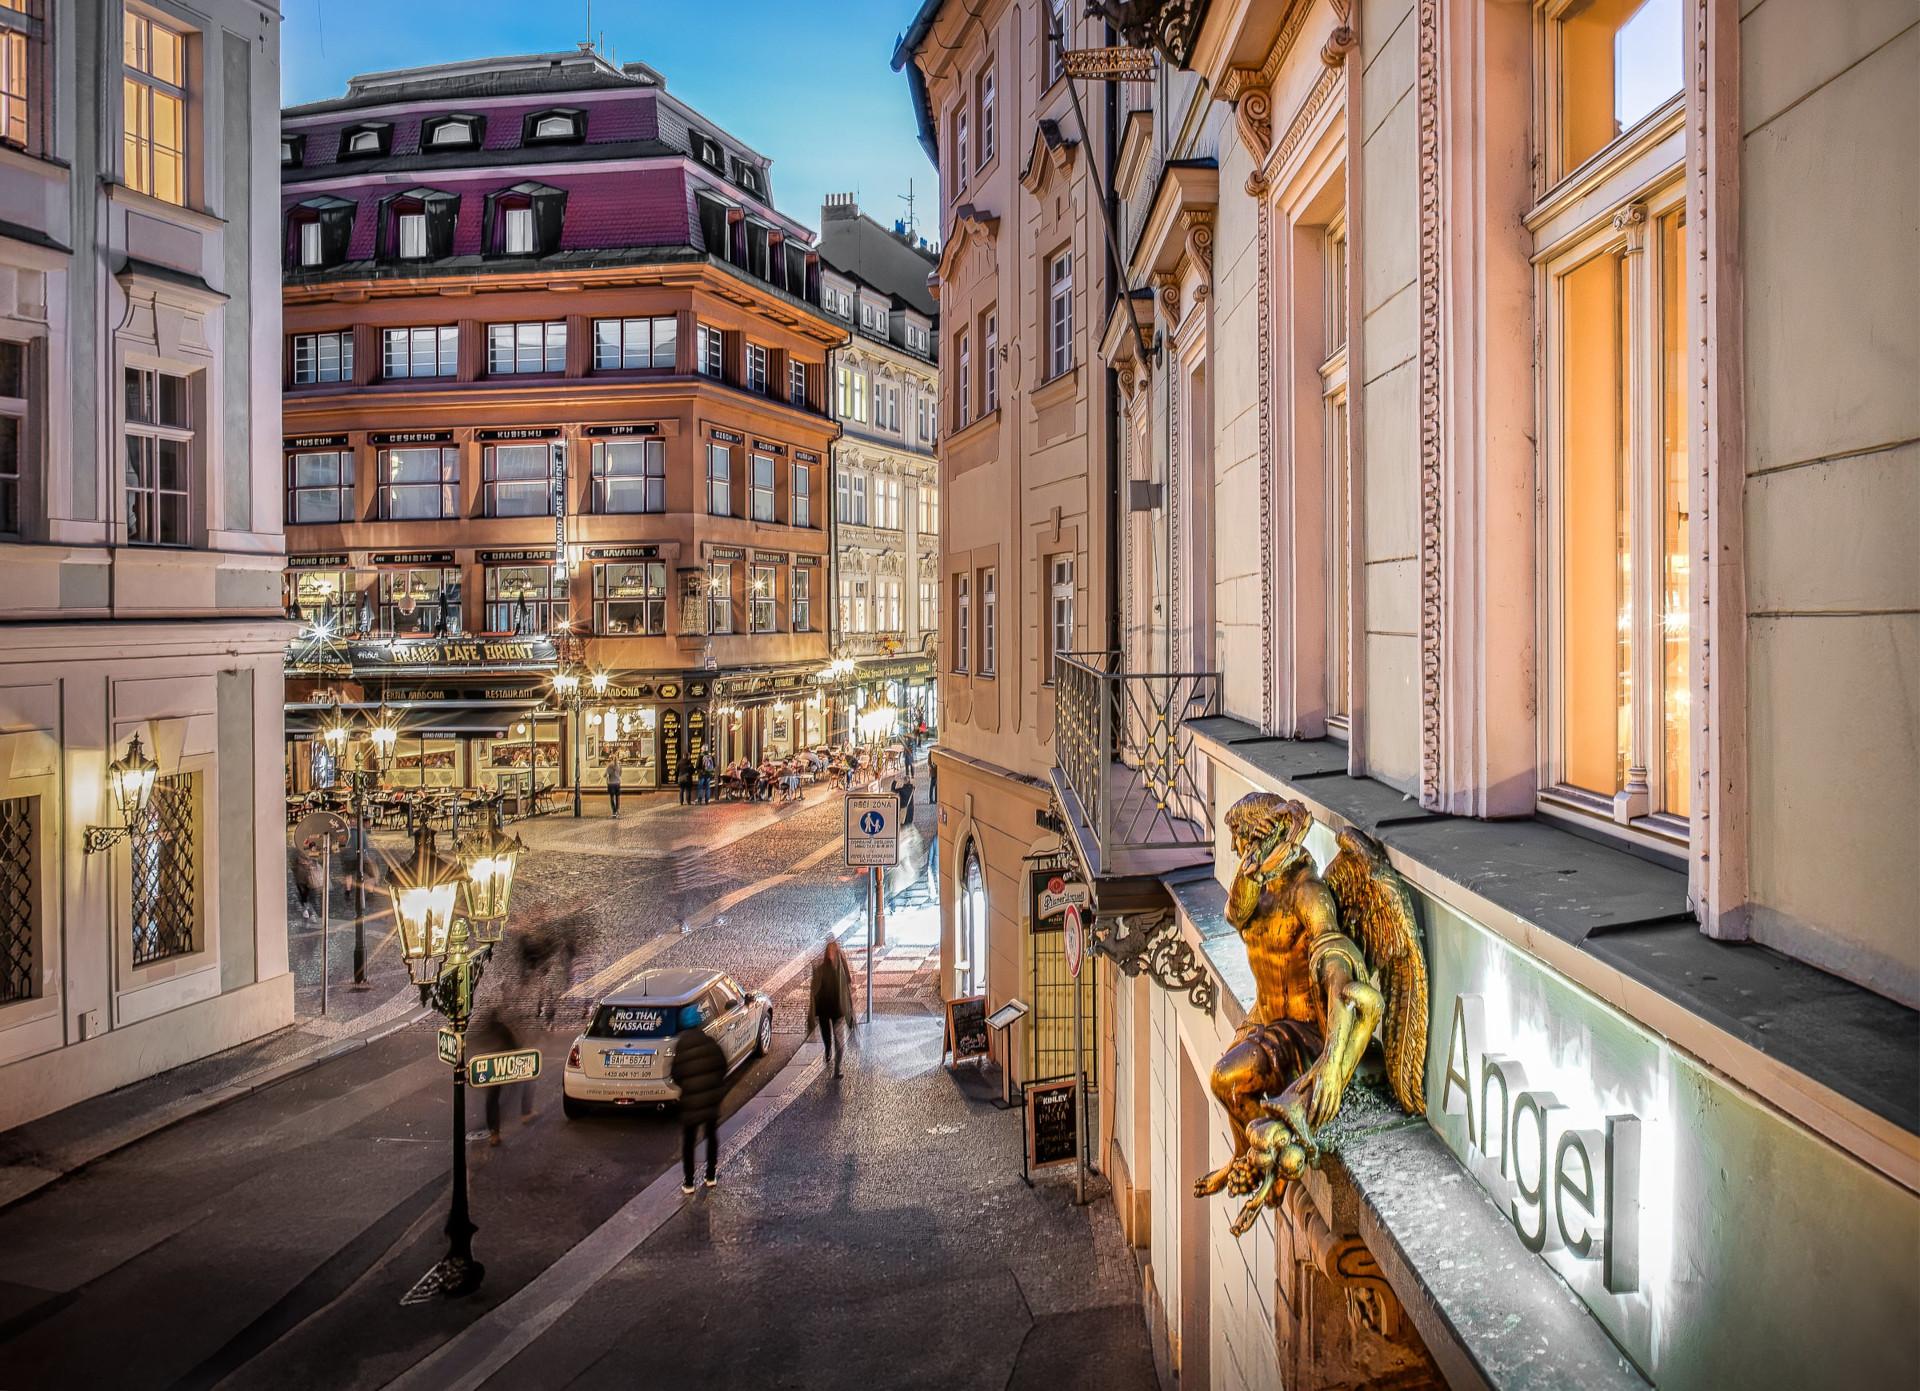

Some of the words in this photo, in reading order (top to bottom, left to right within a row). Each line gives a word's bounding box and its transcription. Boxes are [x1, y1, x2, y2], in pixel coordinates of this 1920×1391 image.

[391, 645, 439, 663] GRAND
[483, 642, 534, 660] ORIENT
[485, 689, 533, 699] RESTAURANT
[872, 799, 892, 809] ZÓNA
[615, 1011, 633, 1020] PRO
[635, 1011, 657, 1020] THAI
[613, 1022, 655, 1031] MASSAGE
[1042, 1093, 1068, 1105] KINLEY
[1443, 993, 1641, 1296] Angel
